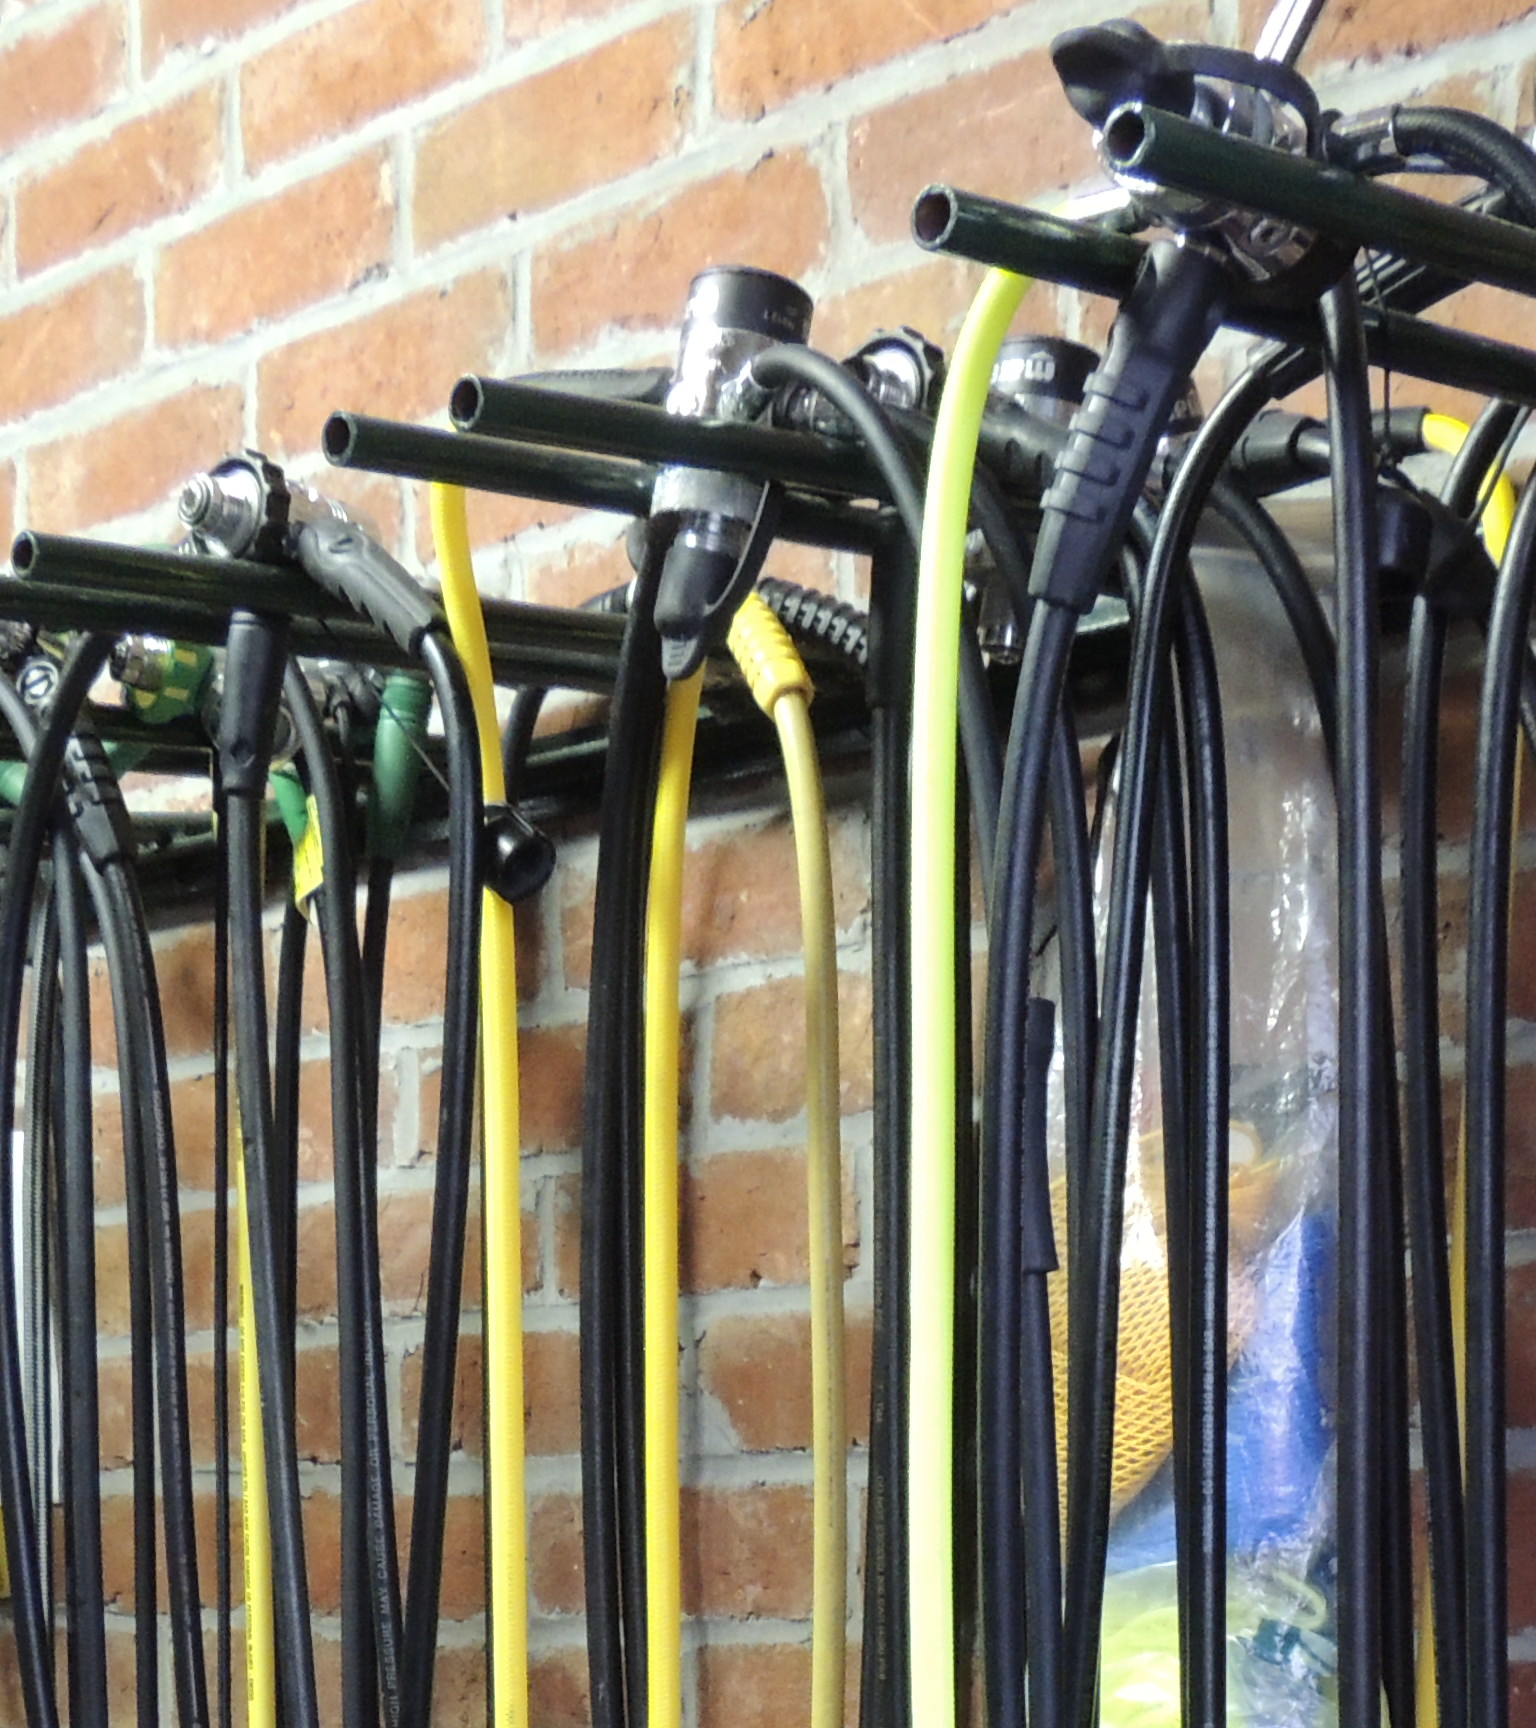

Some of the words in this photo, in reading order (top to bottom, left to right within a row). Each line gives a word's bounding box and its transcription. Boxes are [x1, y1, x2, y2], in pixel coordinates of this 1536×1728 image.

[371, 1475, 385, 1530] DAMAGE
[374, 1534, 388, 1580] CAUSE
[382, 1620, 398, 1690] PRESSURE
